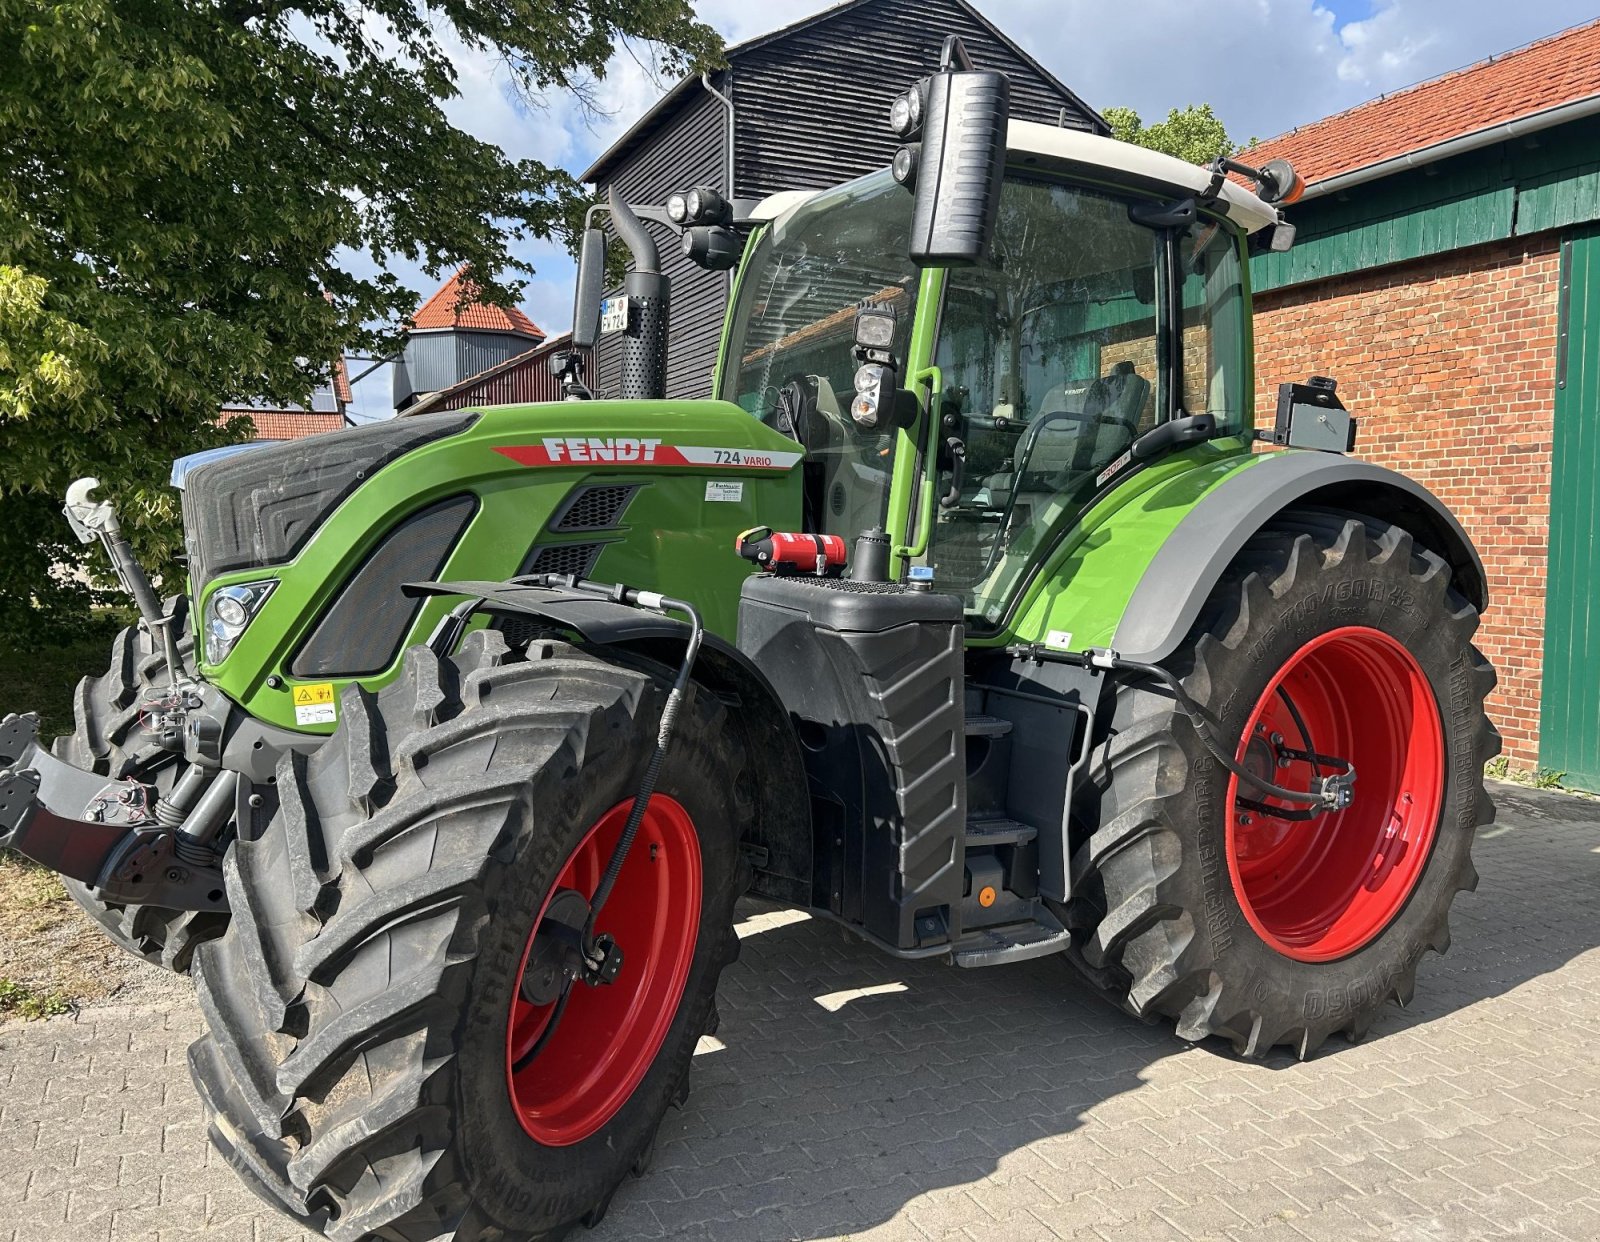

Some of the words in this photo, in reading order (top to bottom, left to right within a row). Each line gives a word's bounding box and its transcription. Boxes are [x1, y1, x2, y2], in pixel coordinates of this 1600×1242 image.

[613, 312, 626, 329] 724
[541, 437, 663, 462] FENDT
[713, 450, 741, 465] 724
[743, 455, 772, 467] VARIO
[1449, 649, 1475, 829] TRELLEBORG
